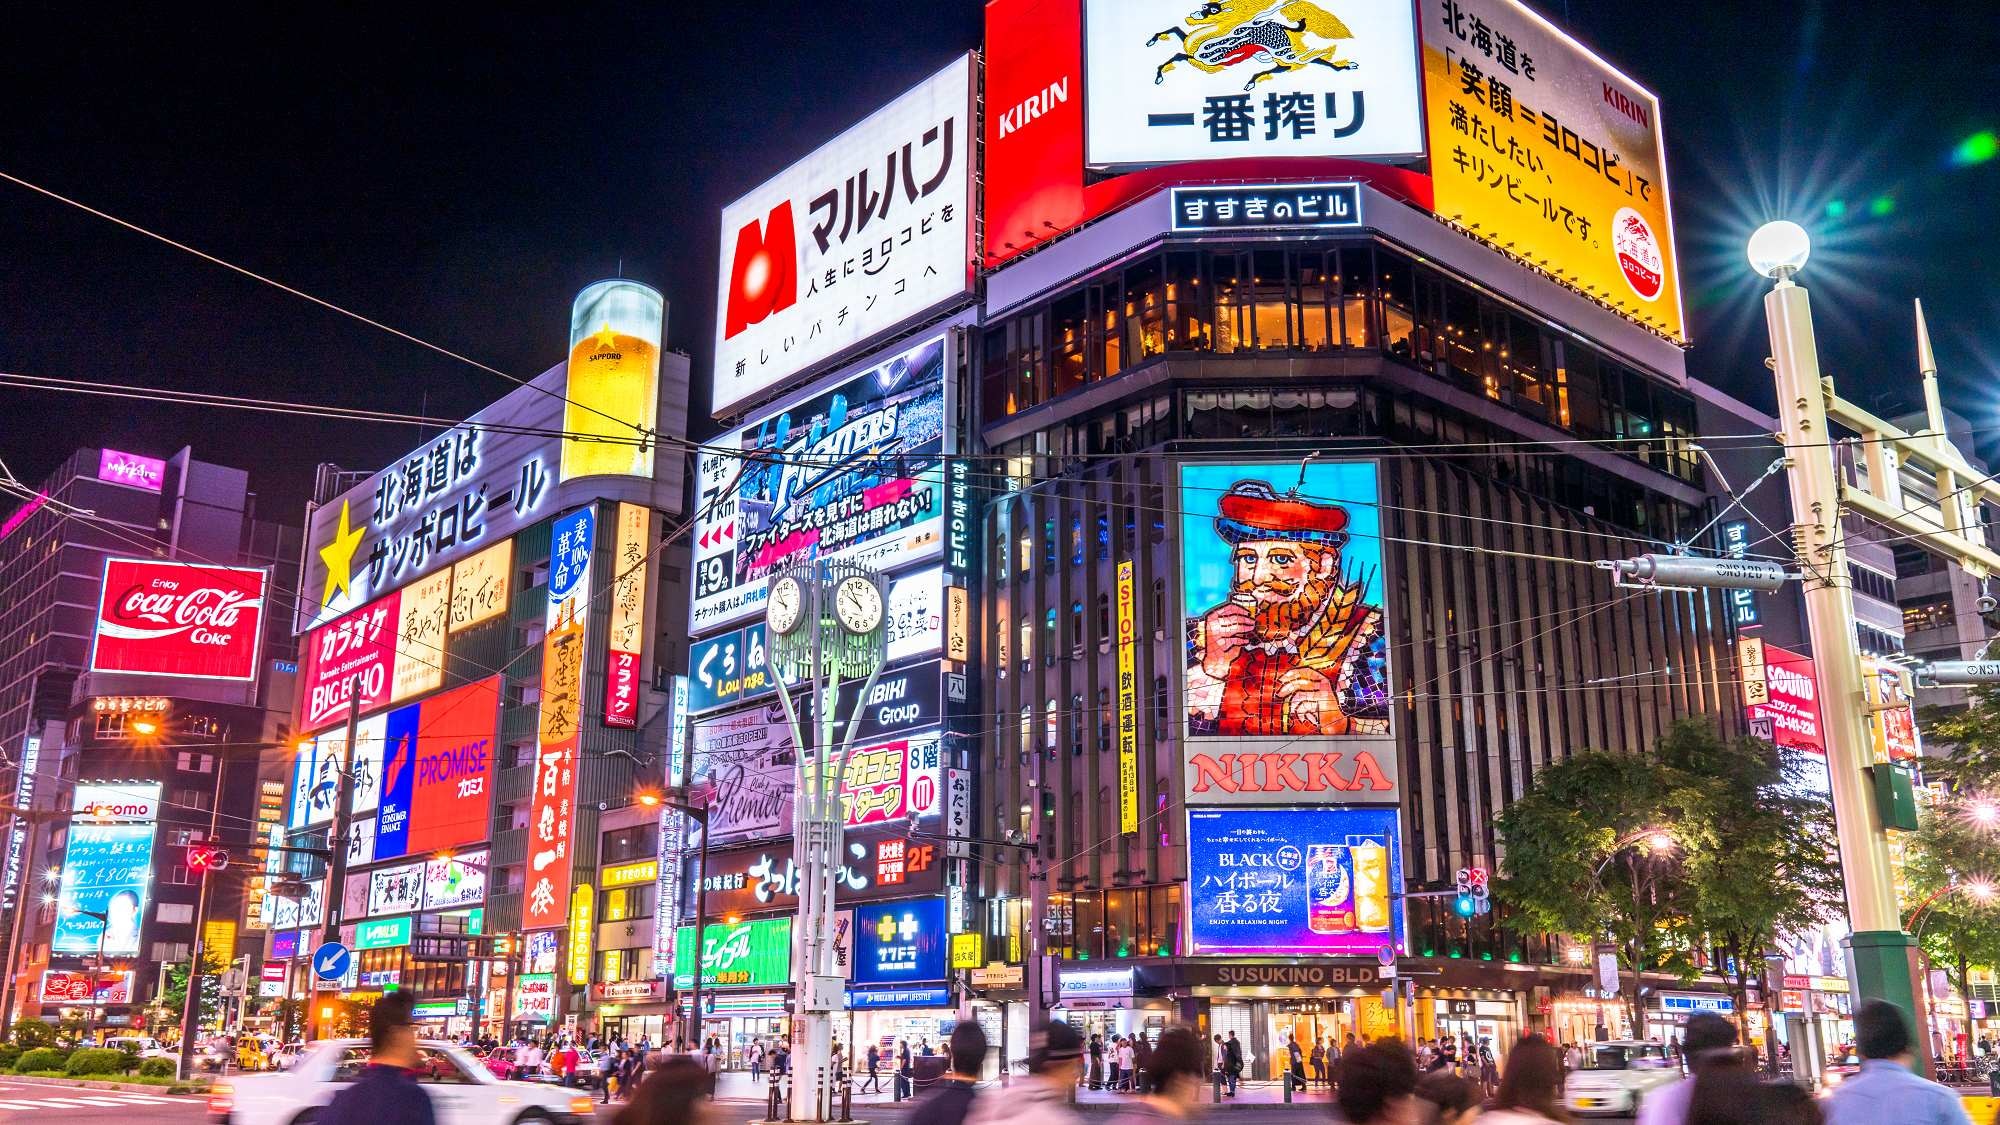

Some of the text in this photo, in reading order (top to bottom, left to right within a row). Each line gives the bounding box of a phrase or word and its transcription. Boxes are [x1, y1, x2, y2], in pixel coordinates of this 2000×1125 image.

[1441, 0, 1537, 81] 北海道を
[999, 76, 1069, 139] KIRIN
[1147, 90, 1365, 143] 一番搾り
[1602, 82, 1649, 129] KIRIN
[1449, 100, 1553, 184] 満たしたい、
[809, 116, 954, 256] マルハン
[1453, 146, 1599, 249] キリンビールです。
[1184, 195, 1349, 221] すすきのビル
[807, 204, 954, 298] 人生にヨロコビを
[1622, 259, 1659, 286] ヨロコビール
[735, 265, 938, 378] 新しいパチンコへ
[589, 353, 623, 362] SAPPORO
[372, 427, 480, 526] 北海道は
[713, 467, 727, 482] まで
[770, 401, 900, 522] FIGHTERS
[369, 458, 550, 590] サッポロビール
[746, 493, 864, 552] ファイターズを見ずに
[554, 531, 571, 591] 革命
[859, 543, 901, 567] ファイターズ
[152, 578, 179, 590] Enjoy
[694, 583, 768, 622] チケット購入はJR札幌
[115, 584, 243, 627] Coca-Cola
[190, 627, 232, 646] Coke
[319, 608, 388, 665] カラオケ
[1120, 584, 1132, 668] STOP!
[320, 667, 340, 681] Karaoke
[341, 650, 379, 672] Entertainment
[614, 653, 631, 714] カラオケ
[717, 671, 764, 697] Lounge
[1767, 664, 1814, 700] SOUND
[880, 703, 920, 726] Group
[1121, 671, 1133, 755] 飲酒運転
[418, 740, 488, 788] PROMISE
[562, 748, 573, 786] 本格
[910, 740, 939, 770] 8階
[1189, 751, 1394, 794] NIKKA
[457, 777, 485, 799] プロミス
[711, 763, 785, 827] Premier
[381, 810, 406, 825] CONSUMER
[381, 820, 401, 834] FINANCE
[907, 845, 933, 872] 2F
[1219, 853, 1275, 867] BLACK
[1200, 871, 1295, 890] ハイボール
[1212, 889, 1285, 913] 香る夜
[1217, 967, 1380, 983] SUSUKINO BLD.
[113, 991, 127, 1001] 2F
[909, 992, 931, 1001] LIFESTYLE
